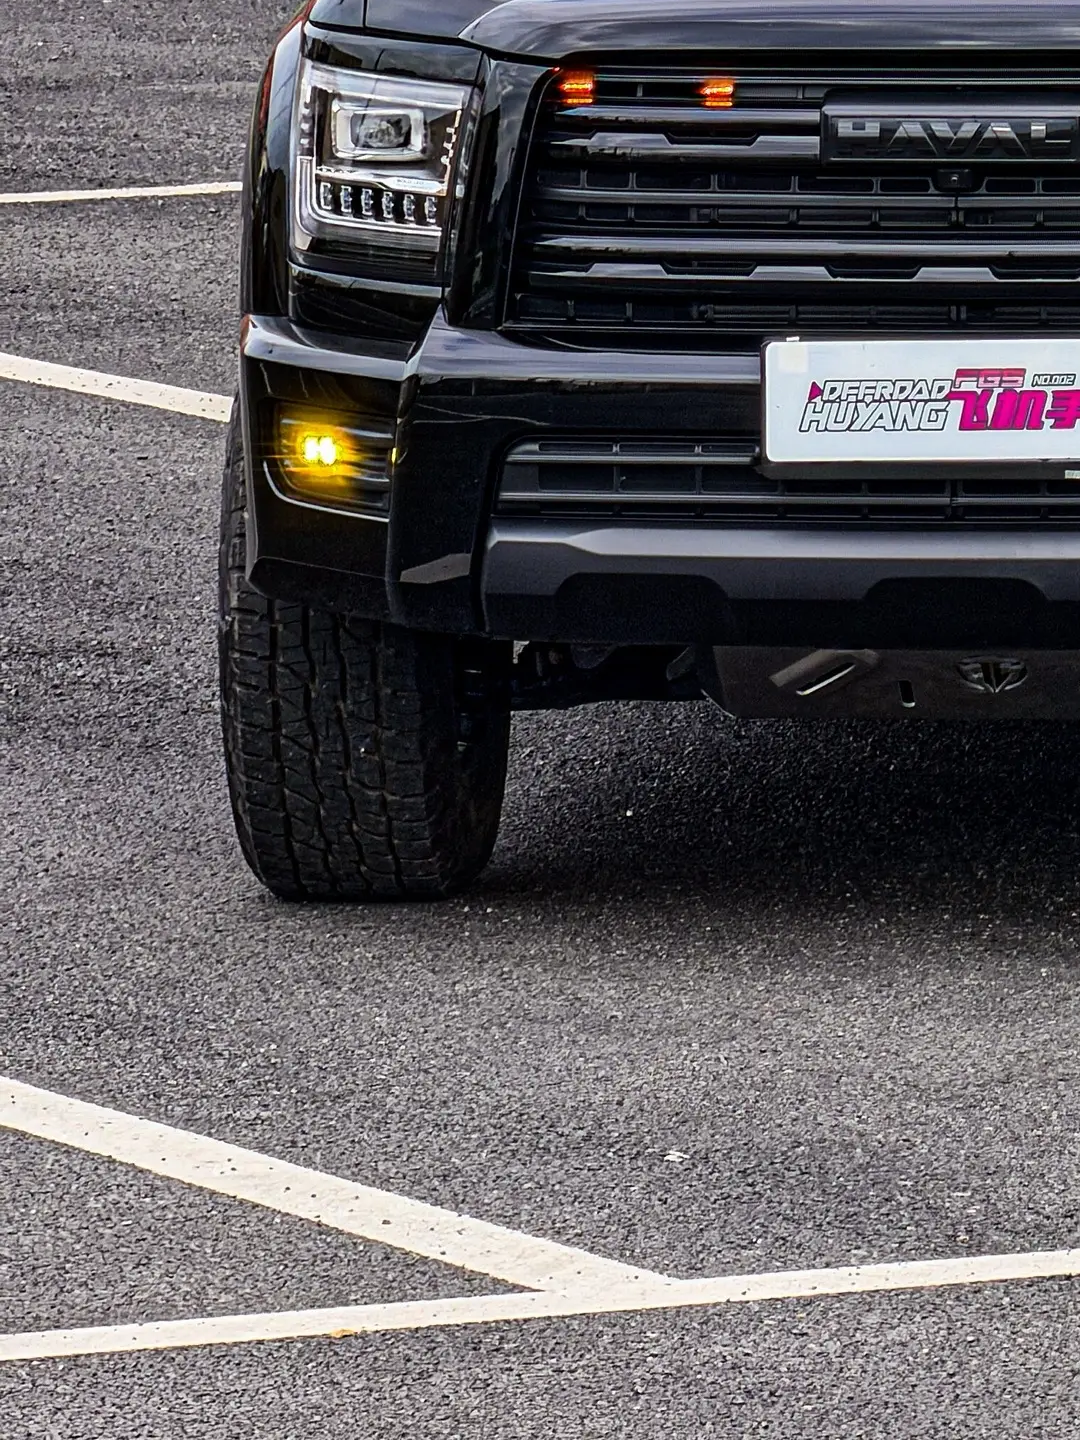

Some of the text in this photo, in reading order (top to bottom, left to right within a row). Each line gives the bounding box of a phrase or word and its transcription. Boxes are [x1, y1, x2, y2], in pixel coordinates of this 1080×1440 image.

[837, 120, 1072, 157] HAVAL
[1032, 374, 1076, 387] NO.002
[799, 400, 949, 432] HUYANG
